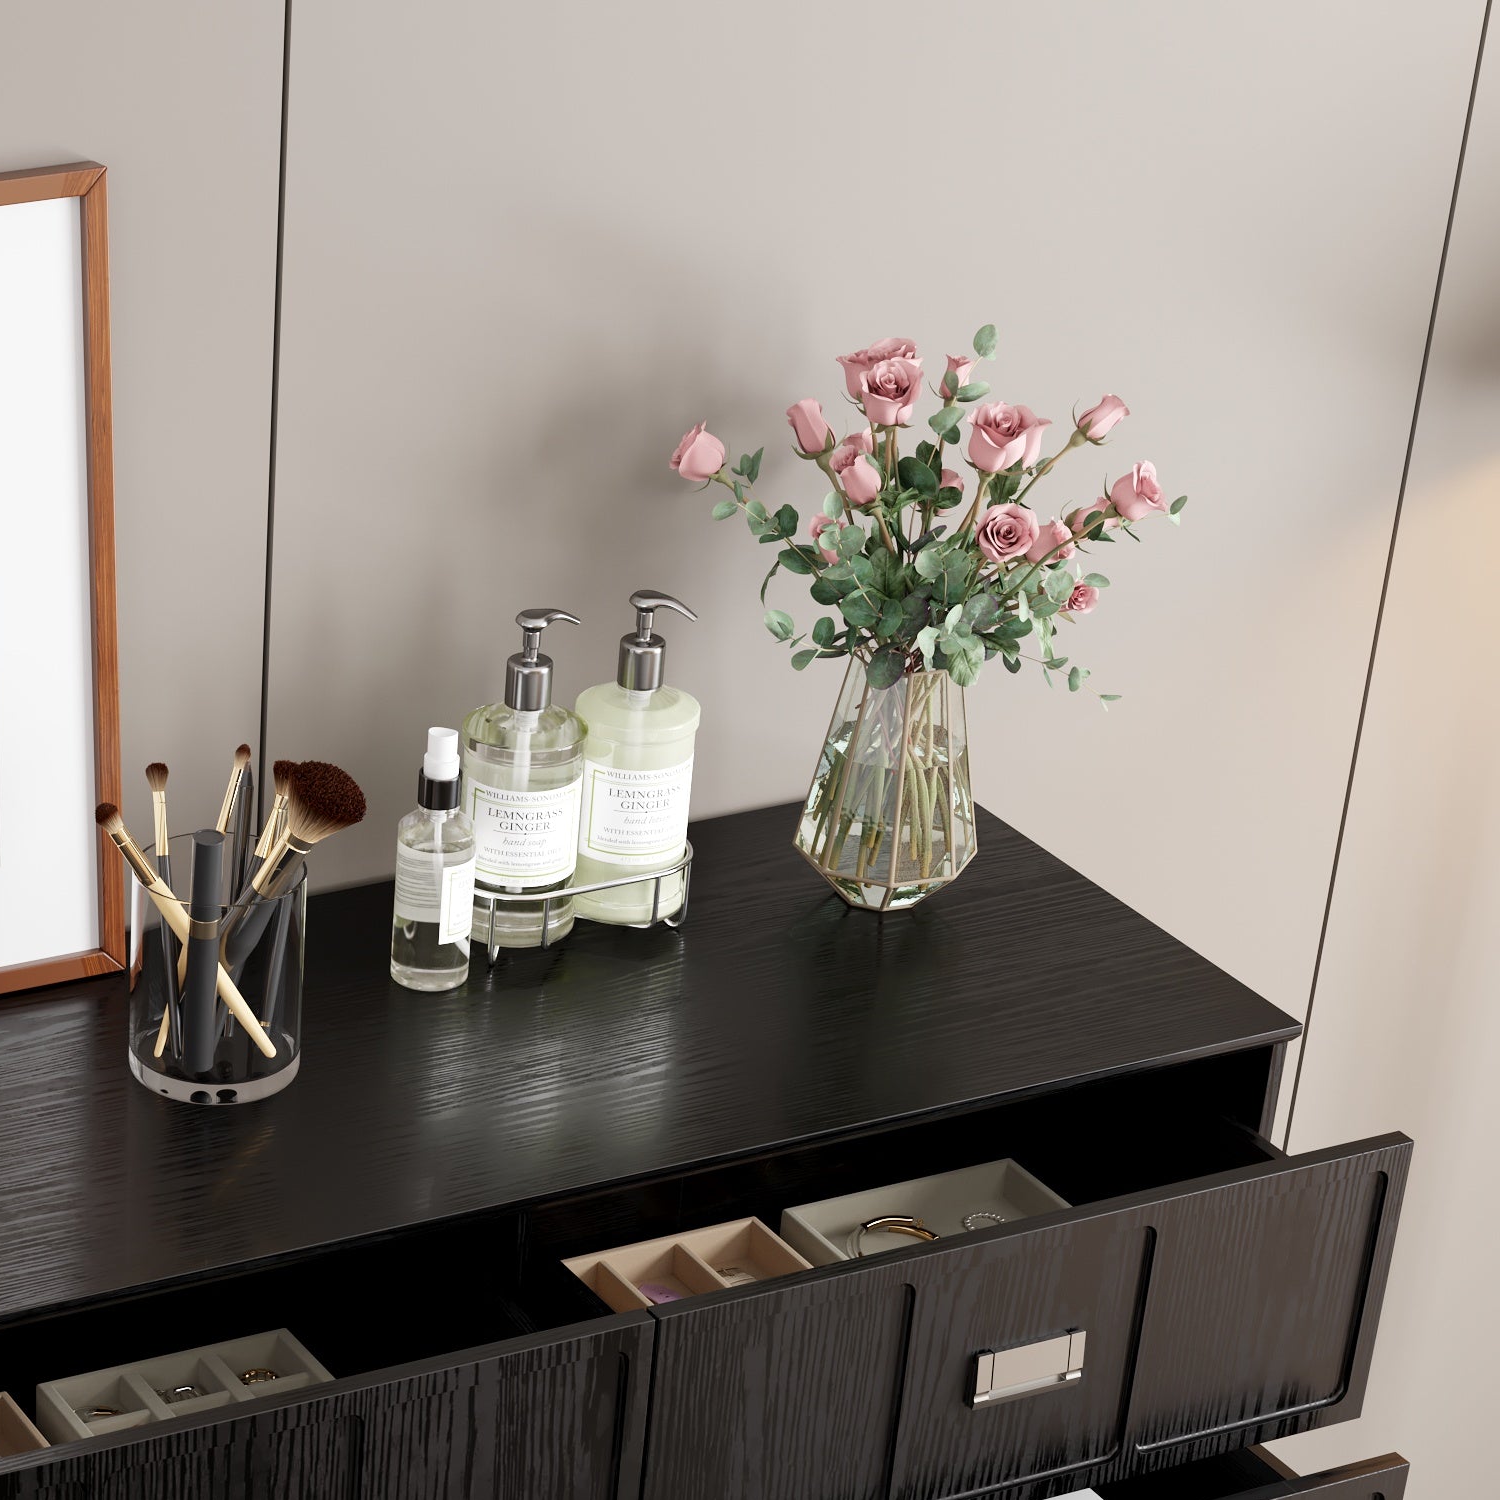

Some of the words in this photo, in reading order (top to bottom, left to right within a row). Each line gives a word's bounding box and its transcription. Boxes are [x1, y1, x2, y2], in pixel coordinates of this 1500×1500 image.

[609, 785, 681, 799] LEMNGRASS
[620, 799, 670, 810] GINGER
[488, 807, 563, 821] LEMNGRASS
[499, 821, 551, 831] GINGER
[502, 836, 527, 846] hand
